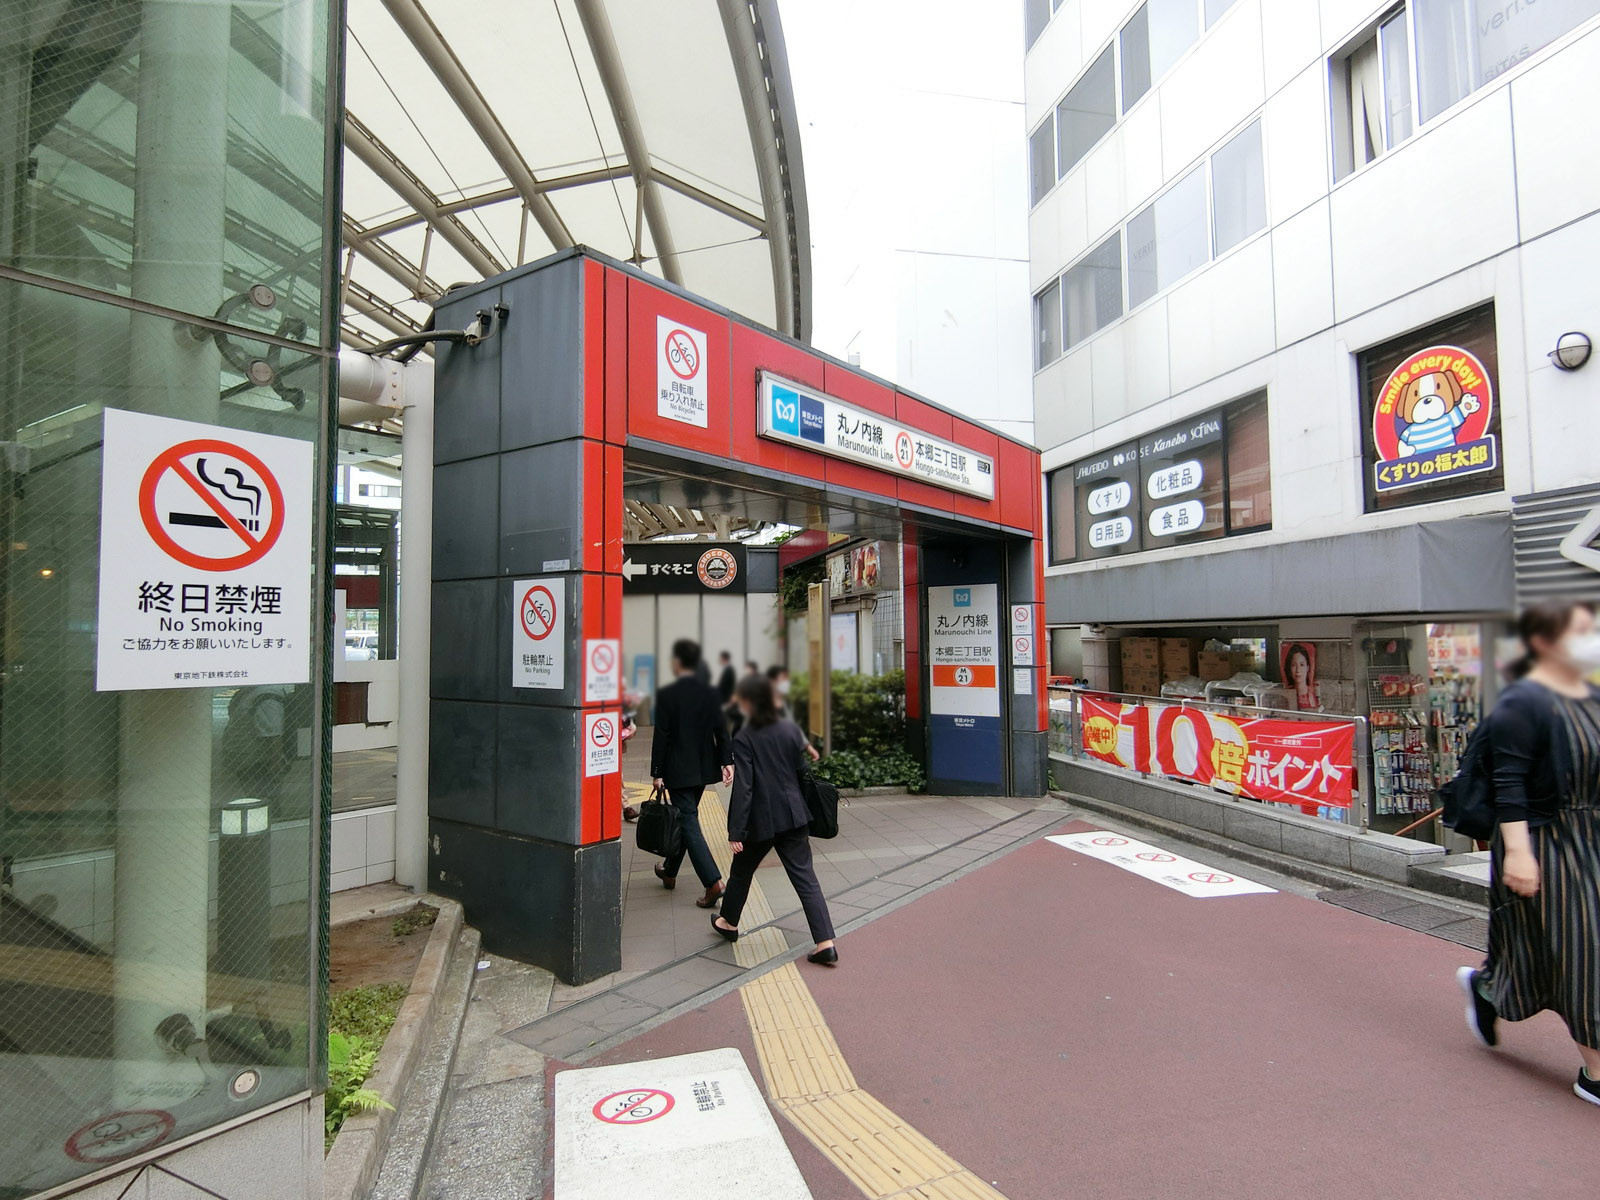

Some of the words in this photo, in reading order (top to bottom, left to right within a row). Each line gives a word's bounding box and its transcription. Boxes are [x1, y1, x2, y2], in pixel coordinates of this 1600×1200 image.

[671, 381, 695, 396] 自転車
[1379, 371, 1411, 415] Smile
[1410, 355, 1453, 374] every
[1451, 357, 1482, 390] day!
[660, 388, 705, 411] 乗り入れ禁止
[837, 412, 883, 445] 丸ノ内線
[837, 434, 879, 458] Marunouchi
[880, 447, 894, 463] Line
[901, 437, 908, 449] M
[1076, 460, 1109, 480] SHISEIDO
[1152, 433, 1187, 454] Kanebo
[1190, 421, 1220, 440] SOFINA
[900, 448, 909, 462] 21
[915, 440, 967, 472] 本郷三丁目駅
[1379, 445, 1489, 483] くすりの福太郎
[915, 458, 960, 483] Hongo-sanchome
[961, 473, 971, 485] Sta.
[1156, 467, 1193, 493] 化粧品
[1095, 487, 1122, 508] くすり
[1161, 508, 1189, 530] 食品
[1095, 522, 1124, 541] 日用品
[650, 563, 694, 575] すぐそこ
[138, 581, 282, 615] 終日禁煙
[160, 617, 184, 632] No
[191, 617, 263, 636] Smoking
[937, 613, 989, 628] 丸ノ内線
[934, 628, 976, 636] Marunouchi
[977, 627, 993, 636] Line
[122, 637, 293, 651] ご協力をお願いいたします。
[935, 645, 992, 657] 本郷三丁目駅
[522, 654, 554, 666] 駐輪禁止
[935, 656, 981, 664] Hongo-sanchome
[174, 670, 249, 680] 東京地下鉄株式会社
[532, 666, 551, 676] Parking
[958, 674, 968, 683] 21
